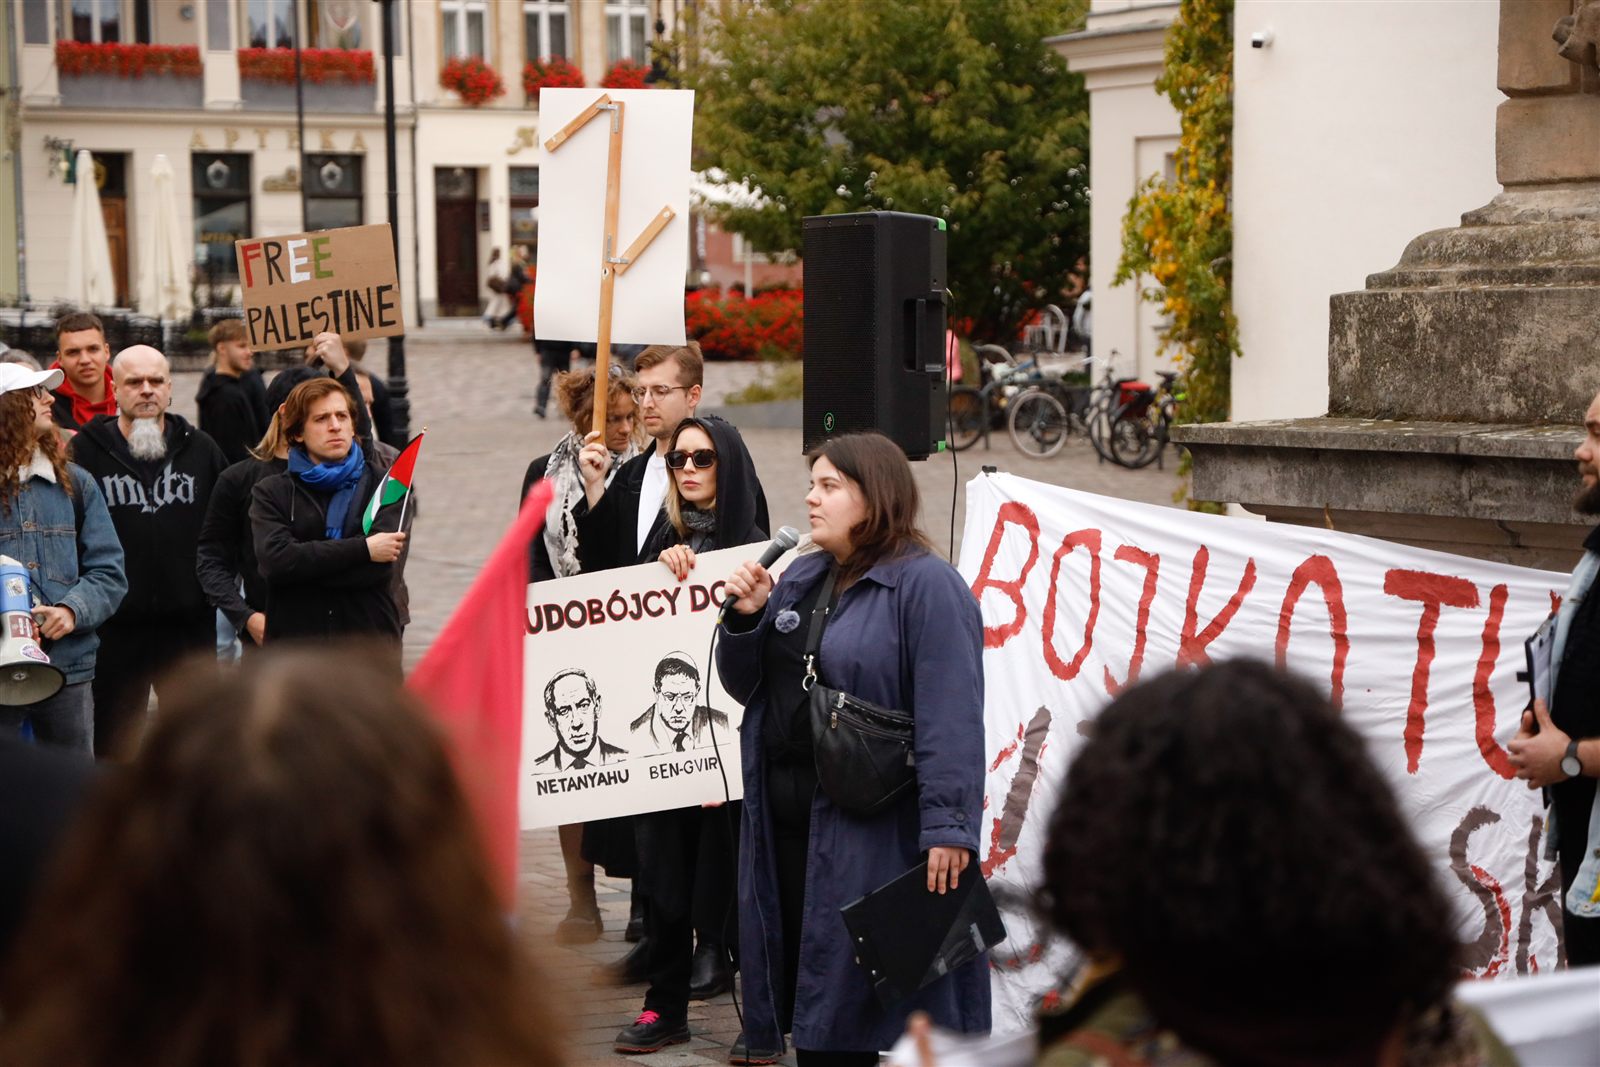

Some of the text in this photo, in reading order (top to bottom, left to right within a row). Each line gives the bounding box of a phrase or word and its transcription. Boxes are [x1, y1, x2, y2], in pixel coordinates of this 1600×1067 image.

[240, 236, 334, 288] FREE
[247, 284, 397, 346] PALESTINE
[523, 586, 682, 637] UDOBÓJCY
[536, 769, 630, 796] NETANYAHU
[649, 757, 718, 780] BEN-GVIR
